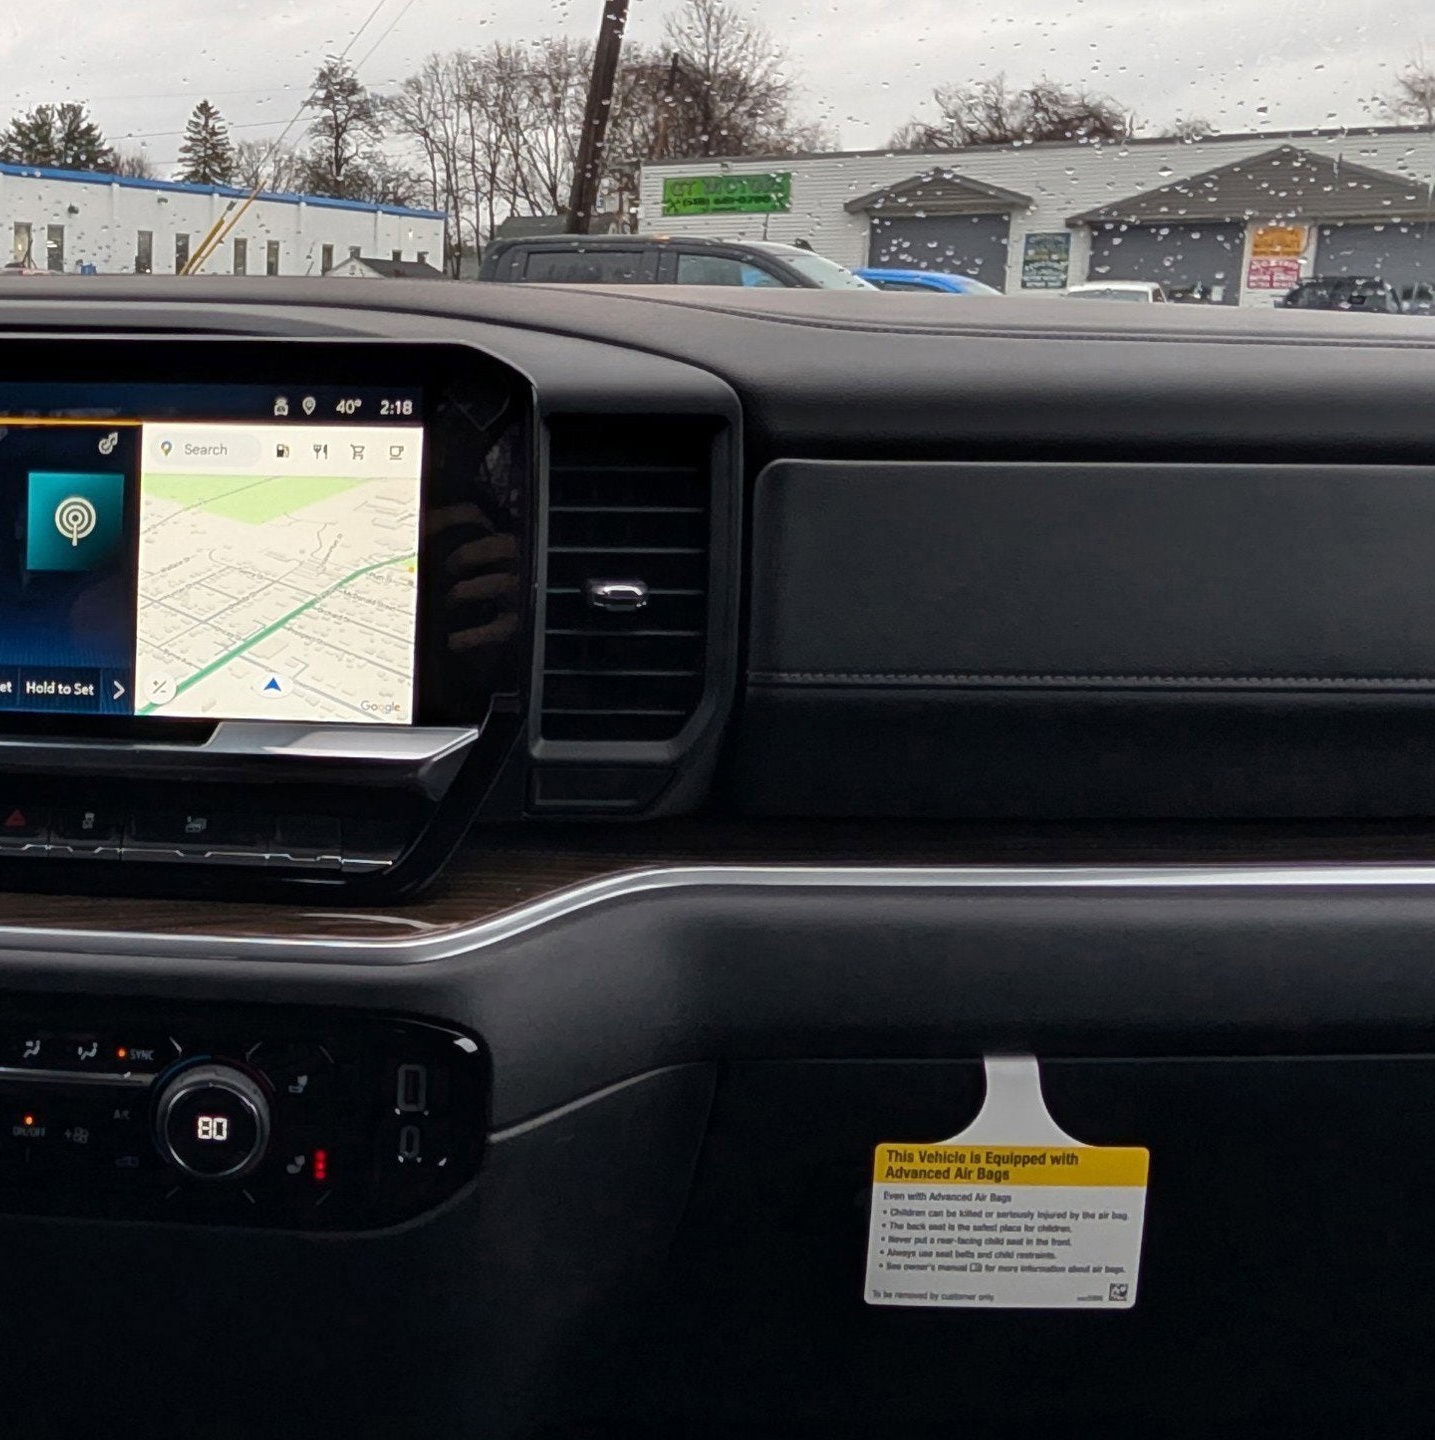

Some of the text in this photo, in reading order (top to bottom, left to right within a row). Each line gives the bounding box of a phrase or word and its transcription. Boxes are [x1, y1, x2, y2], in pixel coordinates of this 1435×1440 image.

[335, 399, 362, 414] 40°
[380, 399, 413, 415] 2:18
[184, 443, 228, 456] Search
[26, 680, 94, 696] Hold to Set
[360, 700, 401, 716] Google
[130, 1049, 154, 1061] SYNC
[197, 1116, 228, 1140] 80
[887, 1149, 1079, 1168] This Vehicle is Equipped with
[885, 1166, 1010, 1183] Advanced Air Bags
[884, 1191, 1012, 1204] Even with Advanced Air Bags
